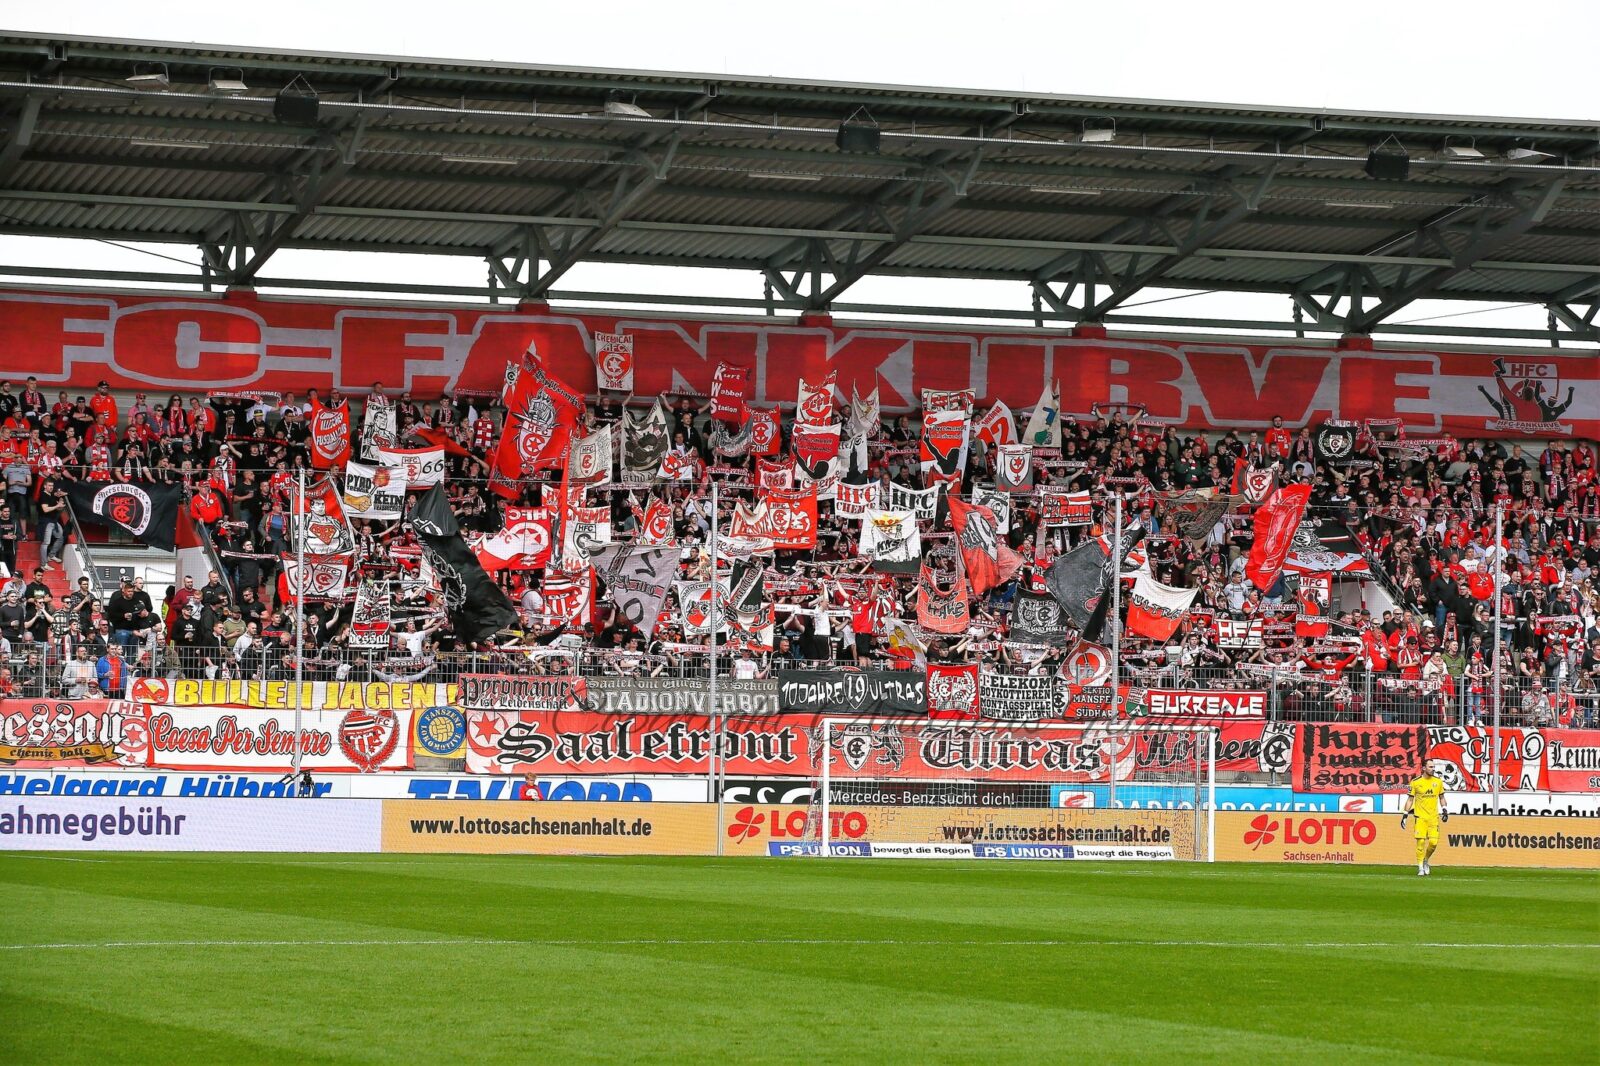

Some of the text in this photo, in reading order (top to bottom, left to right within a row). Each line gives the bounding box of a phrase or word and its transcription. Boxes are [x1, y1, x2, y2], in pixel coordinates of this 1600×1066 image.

[596, 333, 632, 344] CHEMICAL
[1511, 363, 1548, 377] HFC
[605, 380, 623, 390] ZONE
[750, 445, 769, 453] ZONE
[422, 459, 444, 474] 66
[763, 473, 787, 487] 1966
[374, 495, 404, 505] KEIN
[837, 484, 877, 504] HFC
[891, 488, 935, 511] HFC
[1303, 578, 1322, 587] HFC
[174, 680, 314, 710] BULLEN
[322, 683, 444, 712] JAGEN
[869, 682, 924, 704] ULTRAS
[980, 688, 1051, 700] BOYKOTTIEREN
[1073, 694, 1124, 704] MANSFED
[980, 700, 1051, 710] MONTAGSSPIELE
[1151, 696, 1264, 716] SURREALE
[425, 708, 464, 729] FANSZENE
[150, 711, 212, 752] Coesa
[213, 715, 254, 755] Per
[1316, 724, 1416, 751] kurt
[1429, 728, 1463, 746] HFC
[496, 717, 797, 766] Saalefront
[830, 790, 937, 805] Mercedes-Benz
[940, 792, 977, 805] sucht
[981, 793, 1015, 806] dich!
[410, 815, 652, 836] www.lottosachsenanhalt.de
[1284, 818, 1377, 846] LOTTO
[780, 845, 800, 855] PS
[873, 846, 912, 856] bewegt
[915, 845, 931, 855] die
[934, 846, 971, 856] Region
[984, 846, 1172, 859] PS UNION bewegt die Region
[1283, 851, 1354, 862] Sachsen-Anhalt
